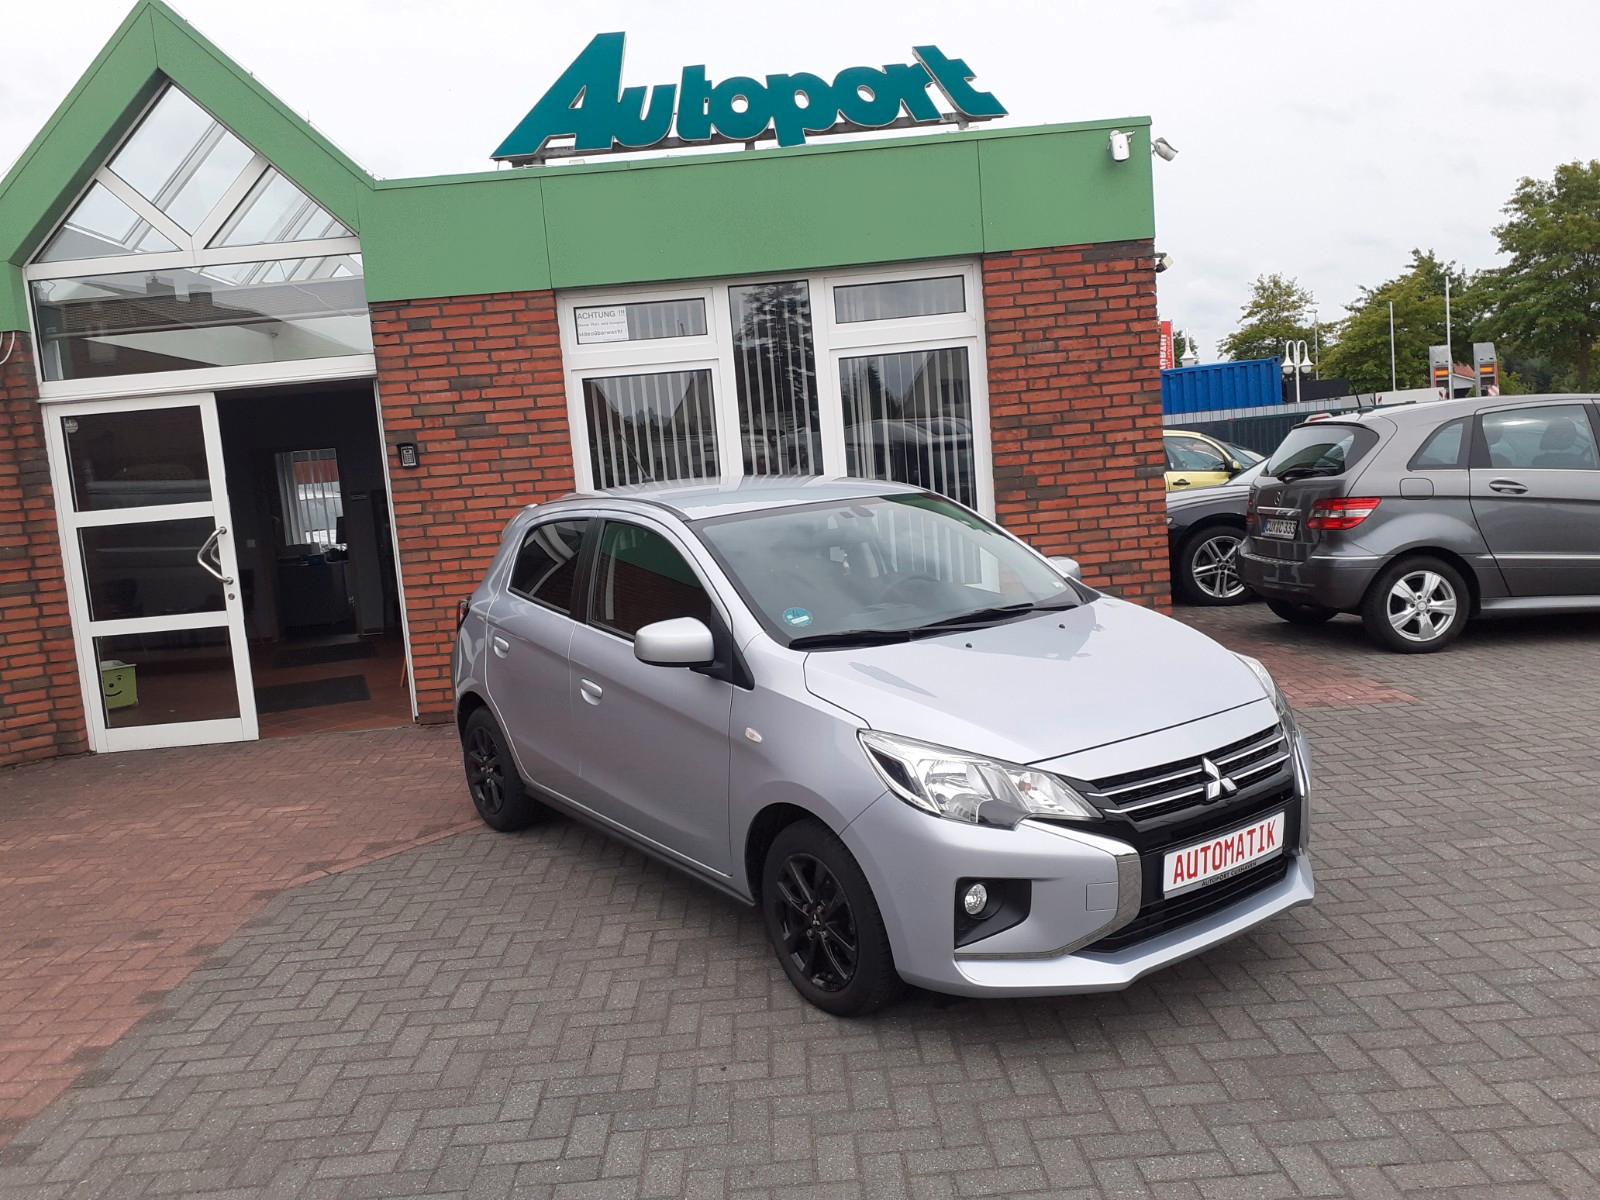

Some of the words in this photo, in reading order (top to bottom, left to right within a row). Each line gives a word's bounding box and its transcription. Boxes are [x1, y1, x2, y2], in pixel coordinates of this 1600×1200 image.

[490, 31, 1009, 158] Autoport
[577, 311, 616, 320] ACHTUNG
[1173, 819, 1276, 885] AUTOMATIK
